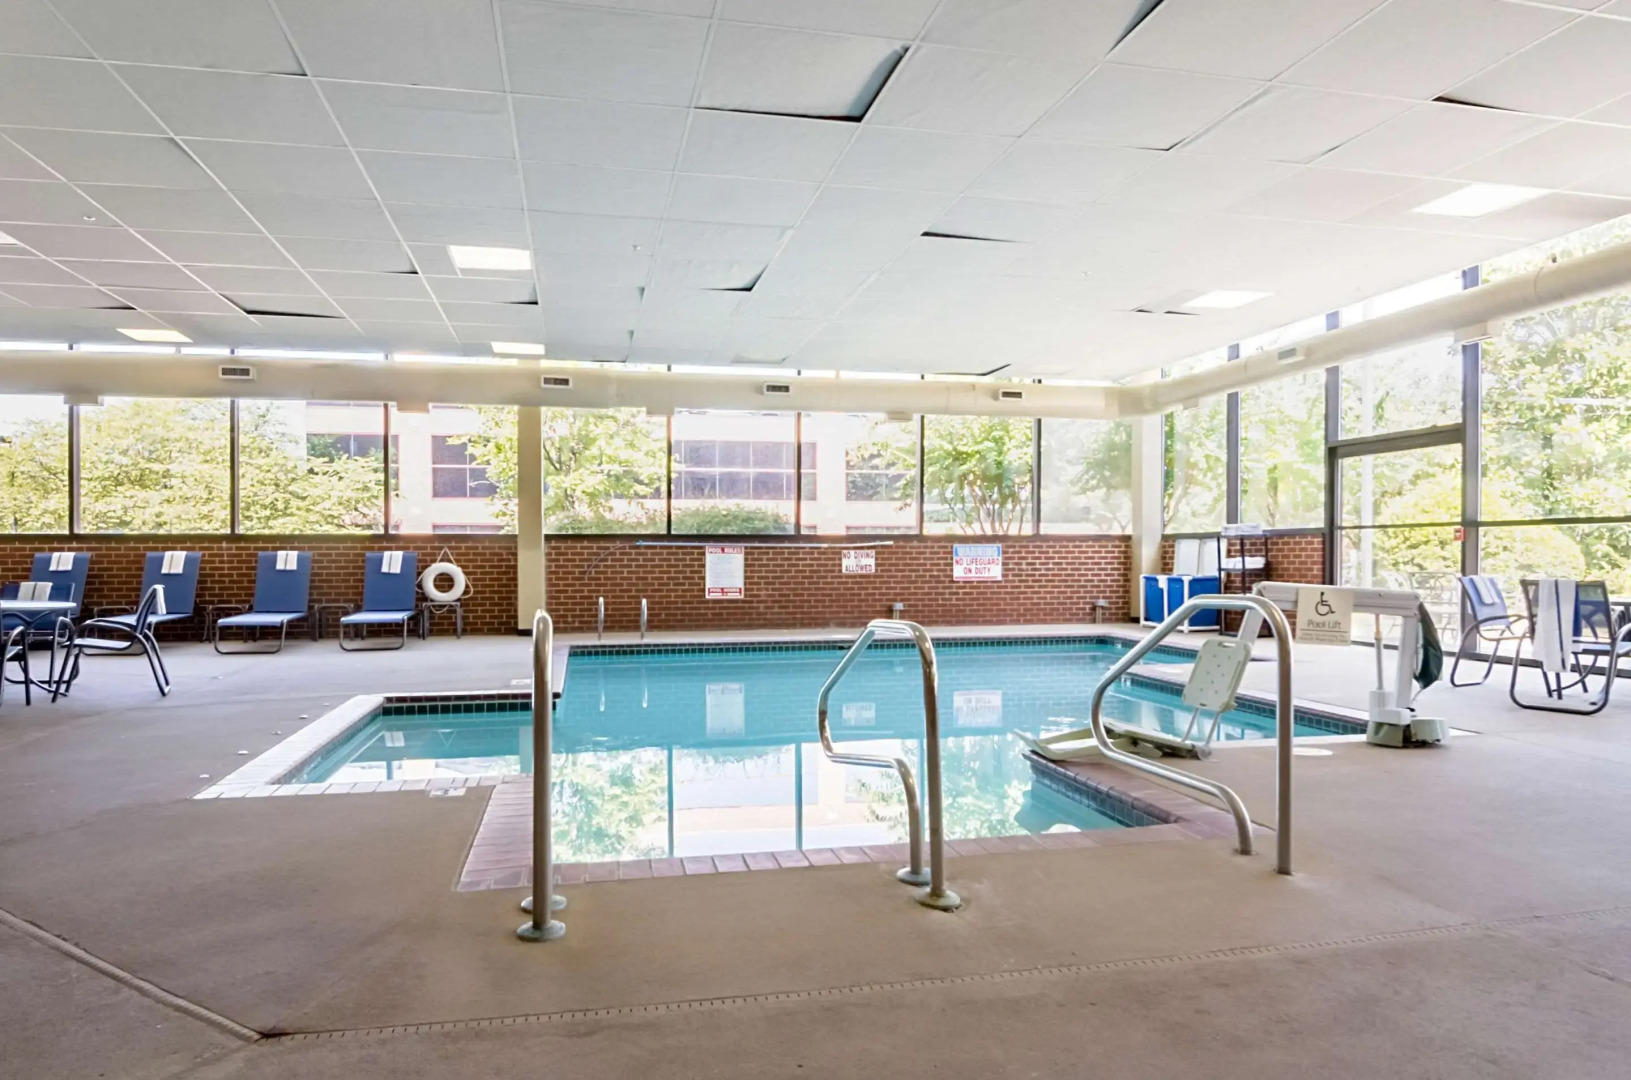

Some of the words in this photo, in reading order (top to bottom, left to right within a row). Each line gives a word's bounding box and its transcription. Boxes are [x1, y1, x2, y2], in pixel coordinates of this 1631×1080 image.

[842, 551, 851, 559] NO
[853, 551, 874, 559] DIVING
[955, 558, 963, 566] NO
[965, 558, 1000, 566] LIFEGUARD
[845, 564, 873, 572] ALLOWED
[963, 567, 972, 575] ON
[975, 567, 991, 575] DUTY
[1307, 619, 1326, 629] Pool
[1327, 620, 1341, 630] Lift
